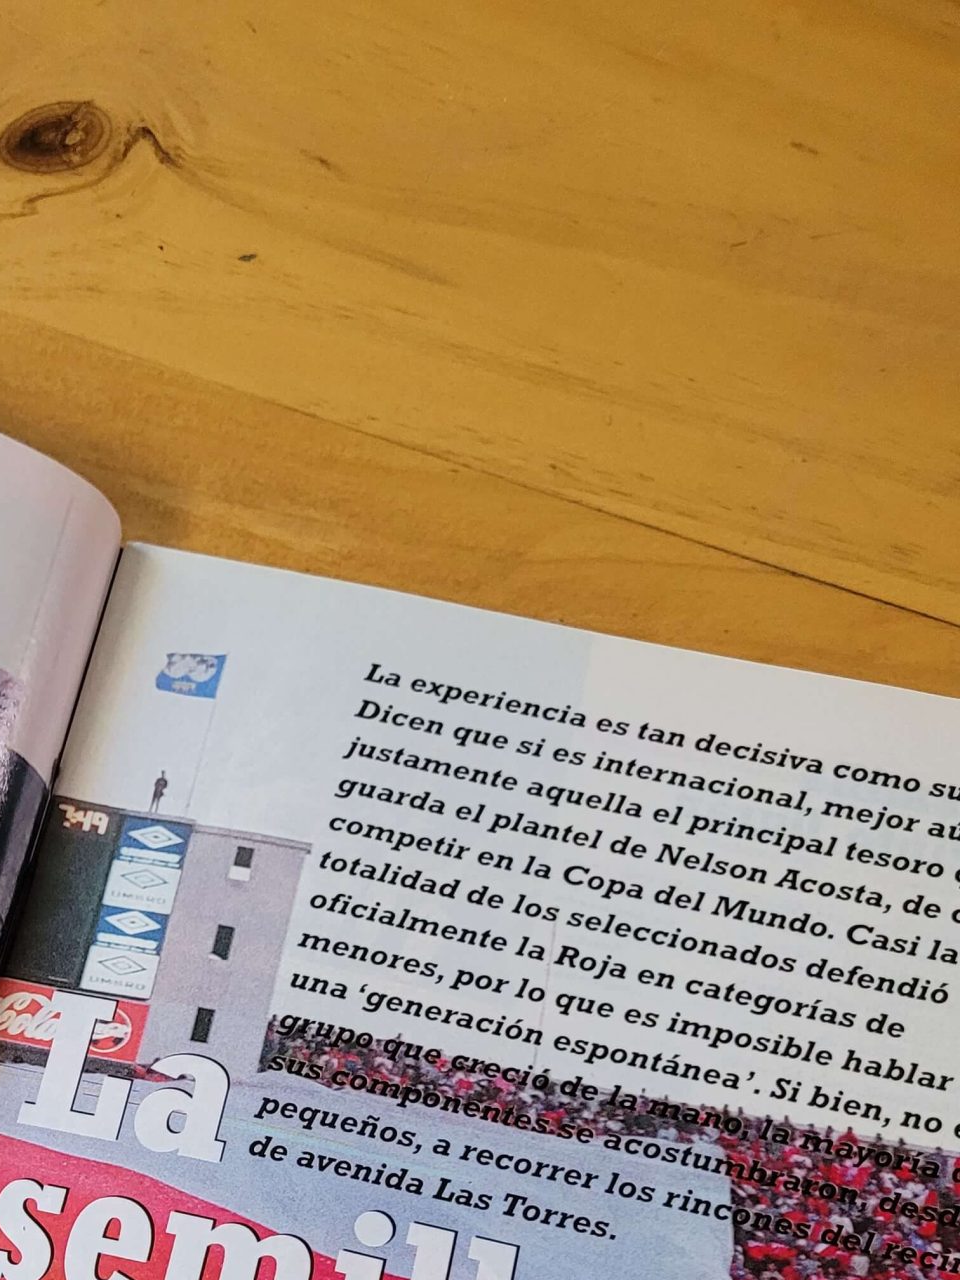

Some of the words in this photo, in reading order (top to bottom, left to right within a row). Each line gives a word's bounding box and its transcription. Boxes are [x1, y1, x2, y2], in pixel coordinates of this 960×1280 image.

[354, 699, 444, 736] Dicen
[453, 726, 509, 749] que
[516, 738, 546, 758] si
[552, 747, 587, 766] es
[592, 751, 813, 817] internacional,
[820, 801, 921, 833] mejor
[364, 663, 401, 688] La
[410, 678, 586, 728] experiencia
[596, 718, 630, 736] es
[637, 722, 686, 748] tan
[694, 733, 823, 775] decisiva
[833, 764, 921, 793] como
[334, 779, 446, 815] guarda
[456, 803, 485, 824] el
[487, 812, 603, 849] plantel
[609, 835, 647, 859] de
[654, 843, 768, 885] Nelson
[774, 868, 892, 914] Acosta,
[902, 894, 942, 919] de
[342, 736, 518, 791] justamente
[526, 781, 643, 818] aquella
[653, 806, 684, 826] el
[685, 815, 838, 857] principal
[845, 842, 945, 878] tesoro
[309, 893, 508, 952] oficialmente
[514, 936, 545, 961] la
[553, 945, 627, 980] Roja
[637, 969, 675, 990] en
[685, 979, 857, 1028] categorías
[865, 1013, 905, 1038] de
[319, 851, 461, 900] totalidad
[466, 885, 504, 909] de
[511, 893, 560, 922] los
[566, 912, 797, 973] seleccionados
[805, 958, 949, 1004] defendió
[328, 817, 471, 860] competir
[477, 851, 514, 871] en
[521, 855, 552, 880] la
[563, 865, 644, 900] Copa
[654, 885, 706, 912] del
[710, 895, 834, 940] Mundo.
[846, 924, 921, 957] Casi
[926, 939, 959, 965] la
[16, 990, 233, 1163] La
[290, 973, 348, 1000] una
[769, 1077, 802, 1103] Si
[807, 1085, 891, 1128] bien,
[899, 1111, 943, 1133] no
[297, 932, 444, 985] menores,
[448, 969, 510, 994] por
[514, 977, 546, 1003] lo
[555, 993, 614, 1018] que
[624, 1008, 660, 1028] es
[666, 1011, 833, 1066] imposible
[840, 1049, 955, 1092] hablar
[268, 1053, 324, 1080] sus
[332, 1069, 558, 1136] componentes
[559, 1121, 594, 1144] se
[603, 1133, 868, 1212] acostumbraron,
[276, 1010, 374, 1049] grupo
[384, 1039, 443, 1064] que
[451, 1053, 550, 1090] creció
[560, 1076, 599, 1101] de
[610, 1085, 638, 1111] la
[649, 1100, 749, 1141] mano,
[760, 1119, 791, 1145] la
[802, 1131, 940, 1179] mayoría
[248, 1135, 288, 1162] de
[296, 1151, 424, 1196] avenida
[431, 1177, 493, 1211] Las
[502, 1192, 617, 1240] Torres.
[253, 1096, 423, 1155] pequeños,
[432, 1138, 451, 1157] a
[458, 1144, 600, 1189] recorrer
[604, 1172, 656, 1203] los
[662, 1189, 812, 1237] rincones
[820, 1225, 877, 1255] del
